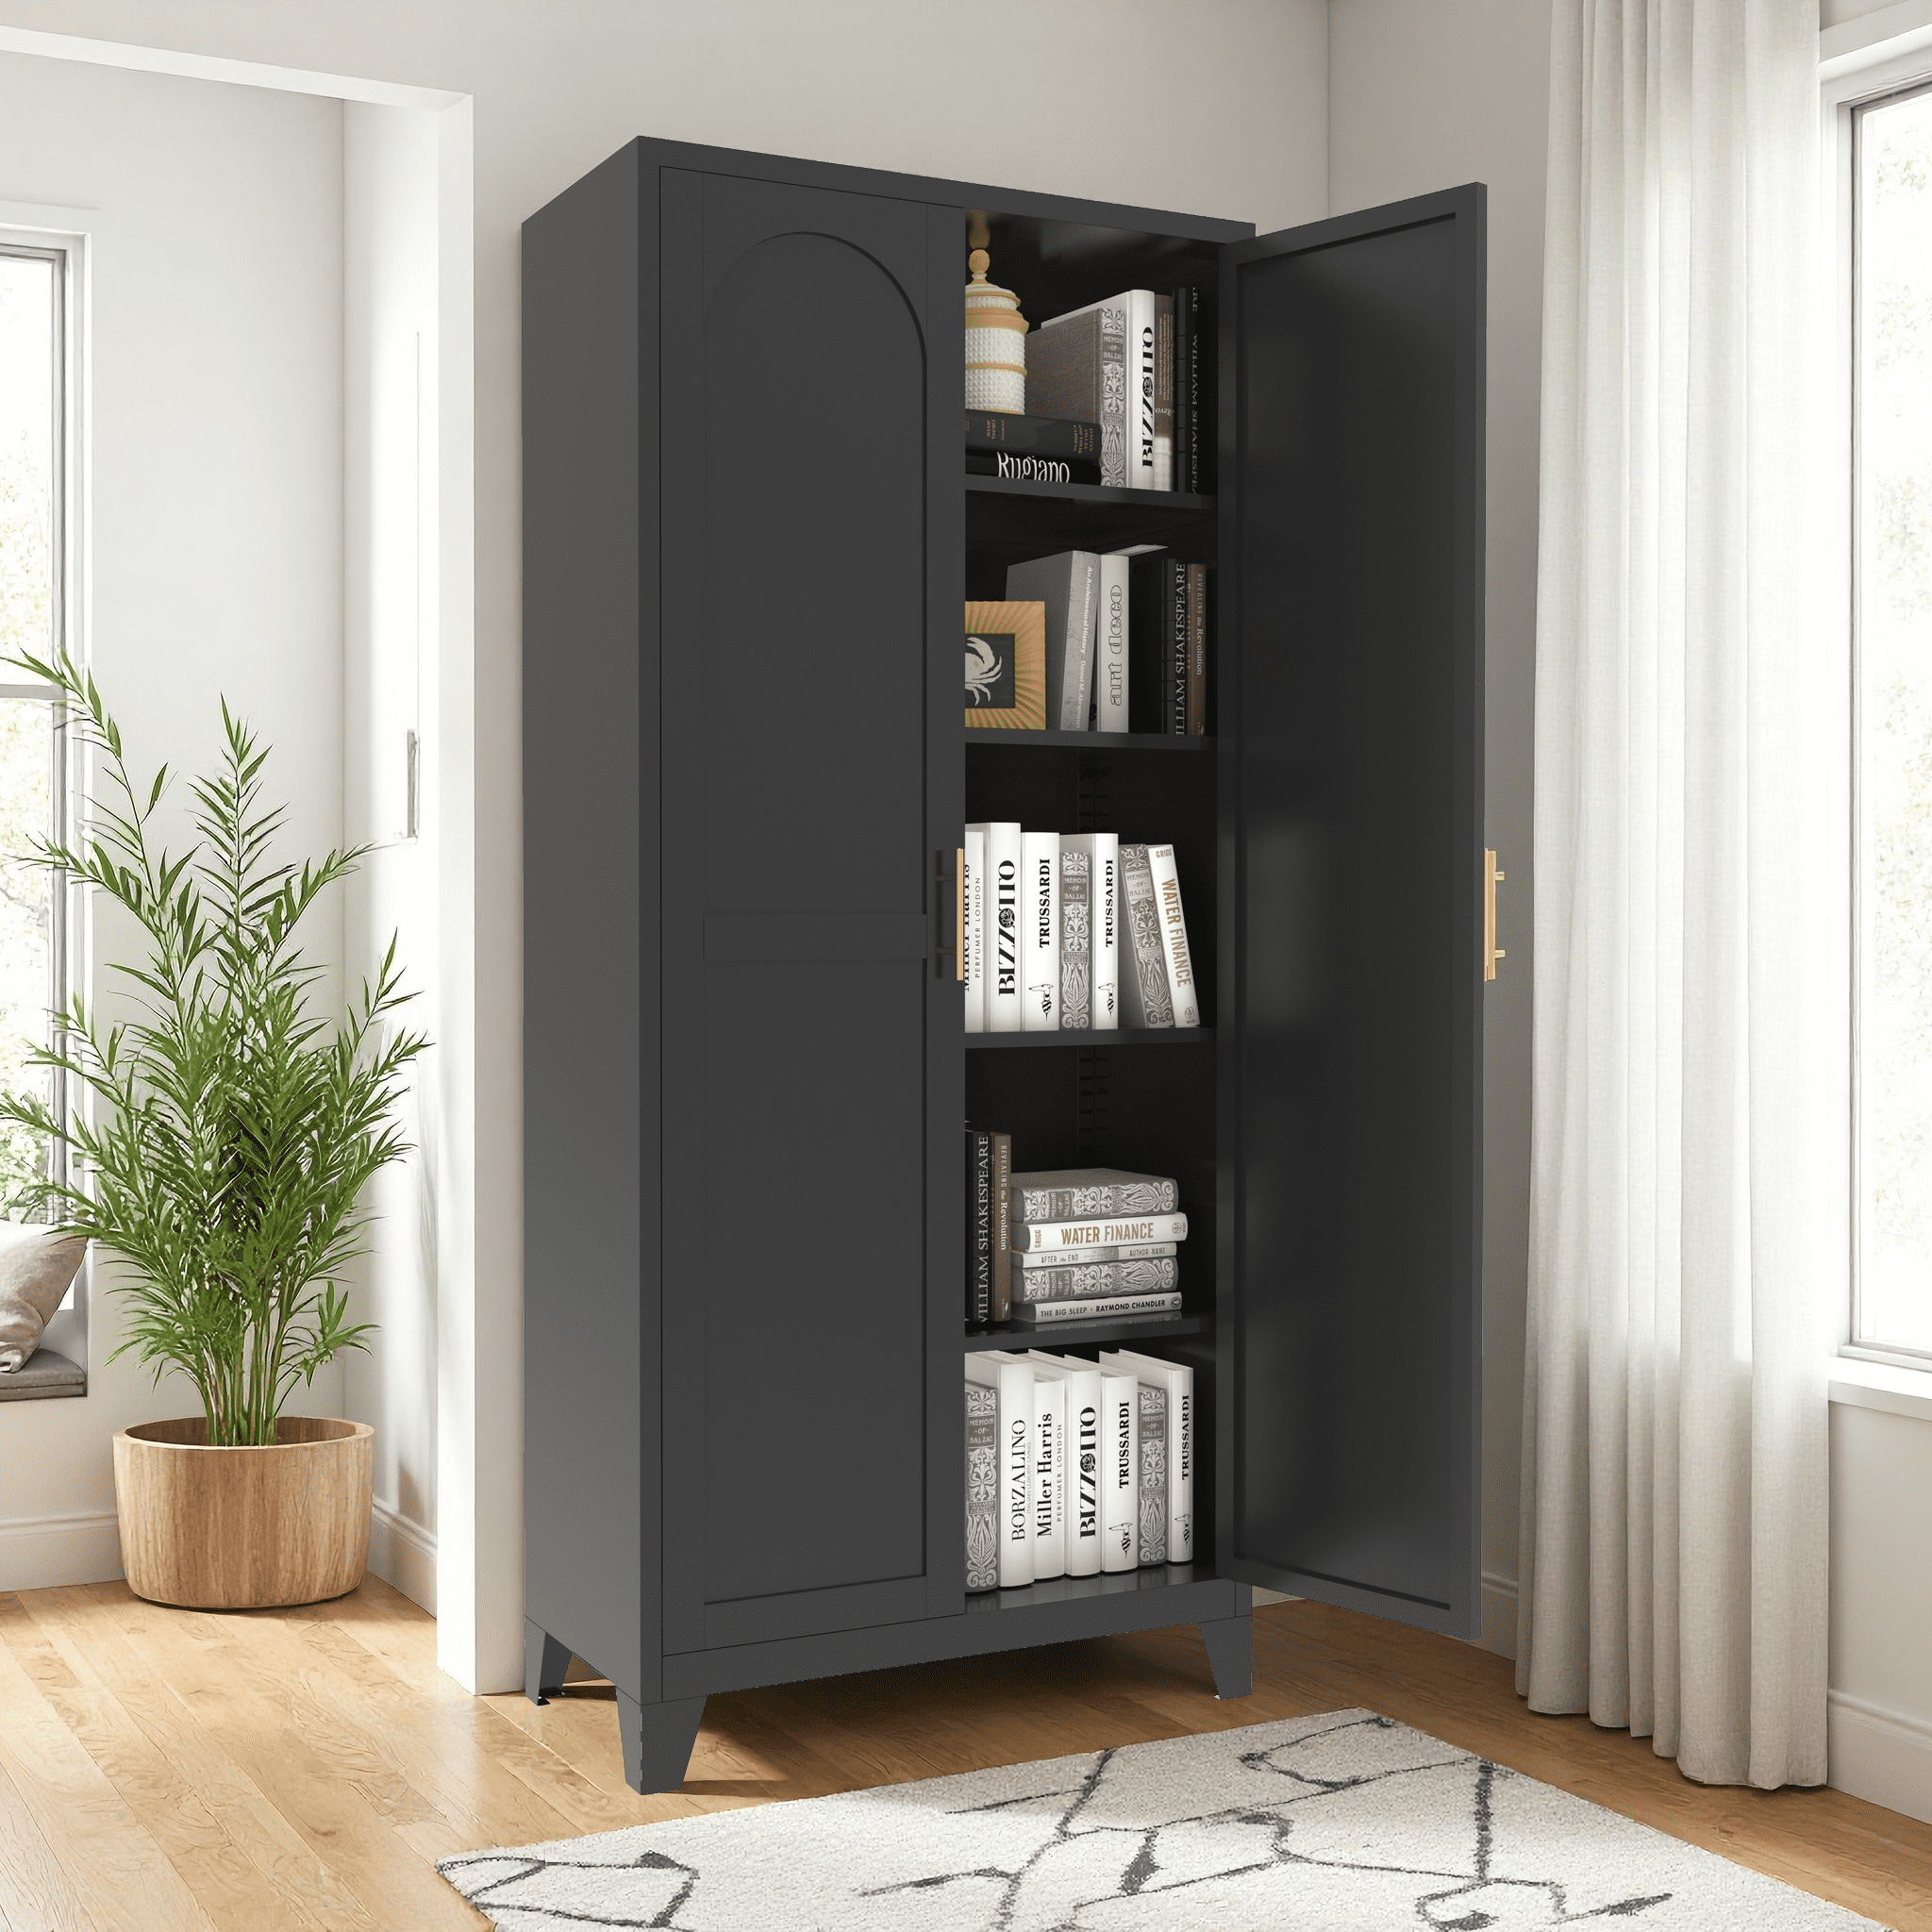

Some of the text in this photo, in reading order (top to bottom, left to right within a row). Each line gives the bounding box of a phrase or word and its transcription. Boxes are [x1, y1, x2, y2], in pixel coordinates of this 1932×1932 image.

[1108, 584, 1123, 707] art deco
[1175, 563, 1186, 736] ILLIAM SHAKESPEARE
[1039, 858, 1051, 948] TRUSSARDI
[1105, 859, 1113, 947] TRUSSARDI
[1161, 878, 1191, 988] WATER FINANCE
[978, 1136, 989, 1251] SHAKESPEARE
[1000, 1202, 1008, 1251] Revolution
[1060, 1223, 1154, 1245] WATER FINANCE
[1034, 1229, 1042, 1249] GRIGG
[1041, 1256, 1058, 1264] AFTER
[1068, 1254, 1079, 1262] END
[1128, 1247, 1166, 1257] AUTHOR NAME
[1055, 1308, 1067, 1317] BIG
[1069, 1307, 1088, 1315] SLEEP
[1095, 1302, 1130, 1312] RAYMOND
[1131, 1299, 1166, 1309] CHANDLER
[969, 1418, 994, 1426] MEMOIR
[969, 1435, 993, 1444] BALZAC
[1119, 1401, 1130, 1489] TRUSSARDI
[1011, 1419, 1026, 1541] BORZALINO
[1037, 1413, 1052, 1538] Miller Harris
